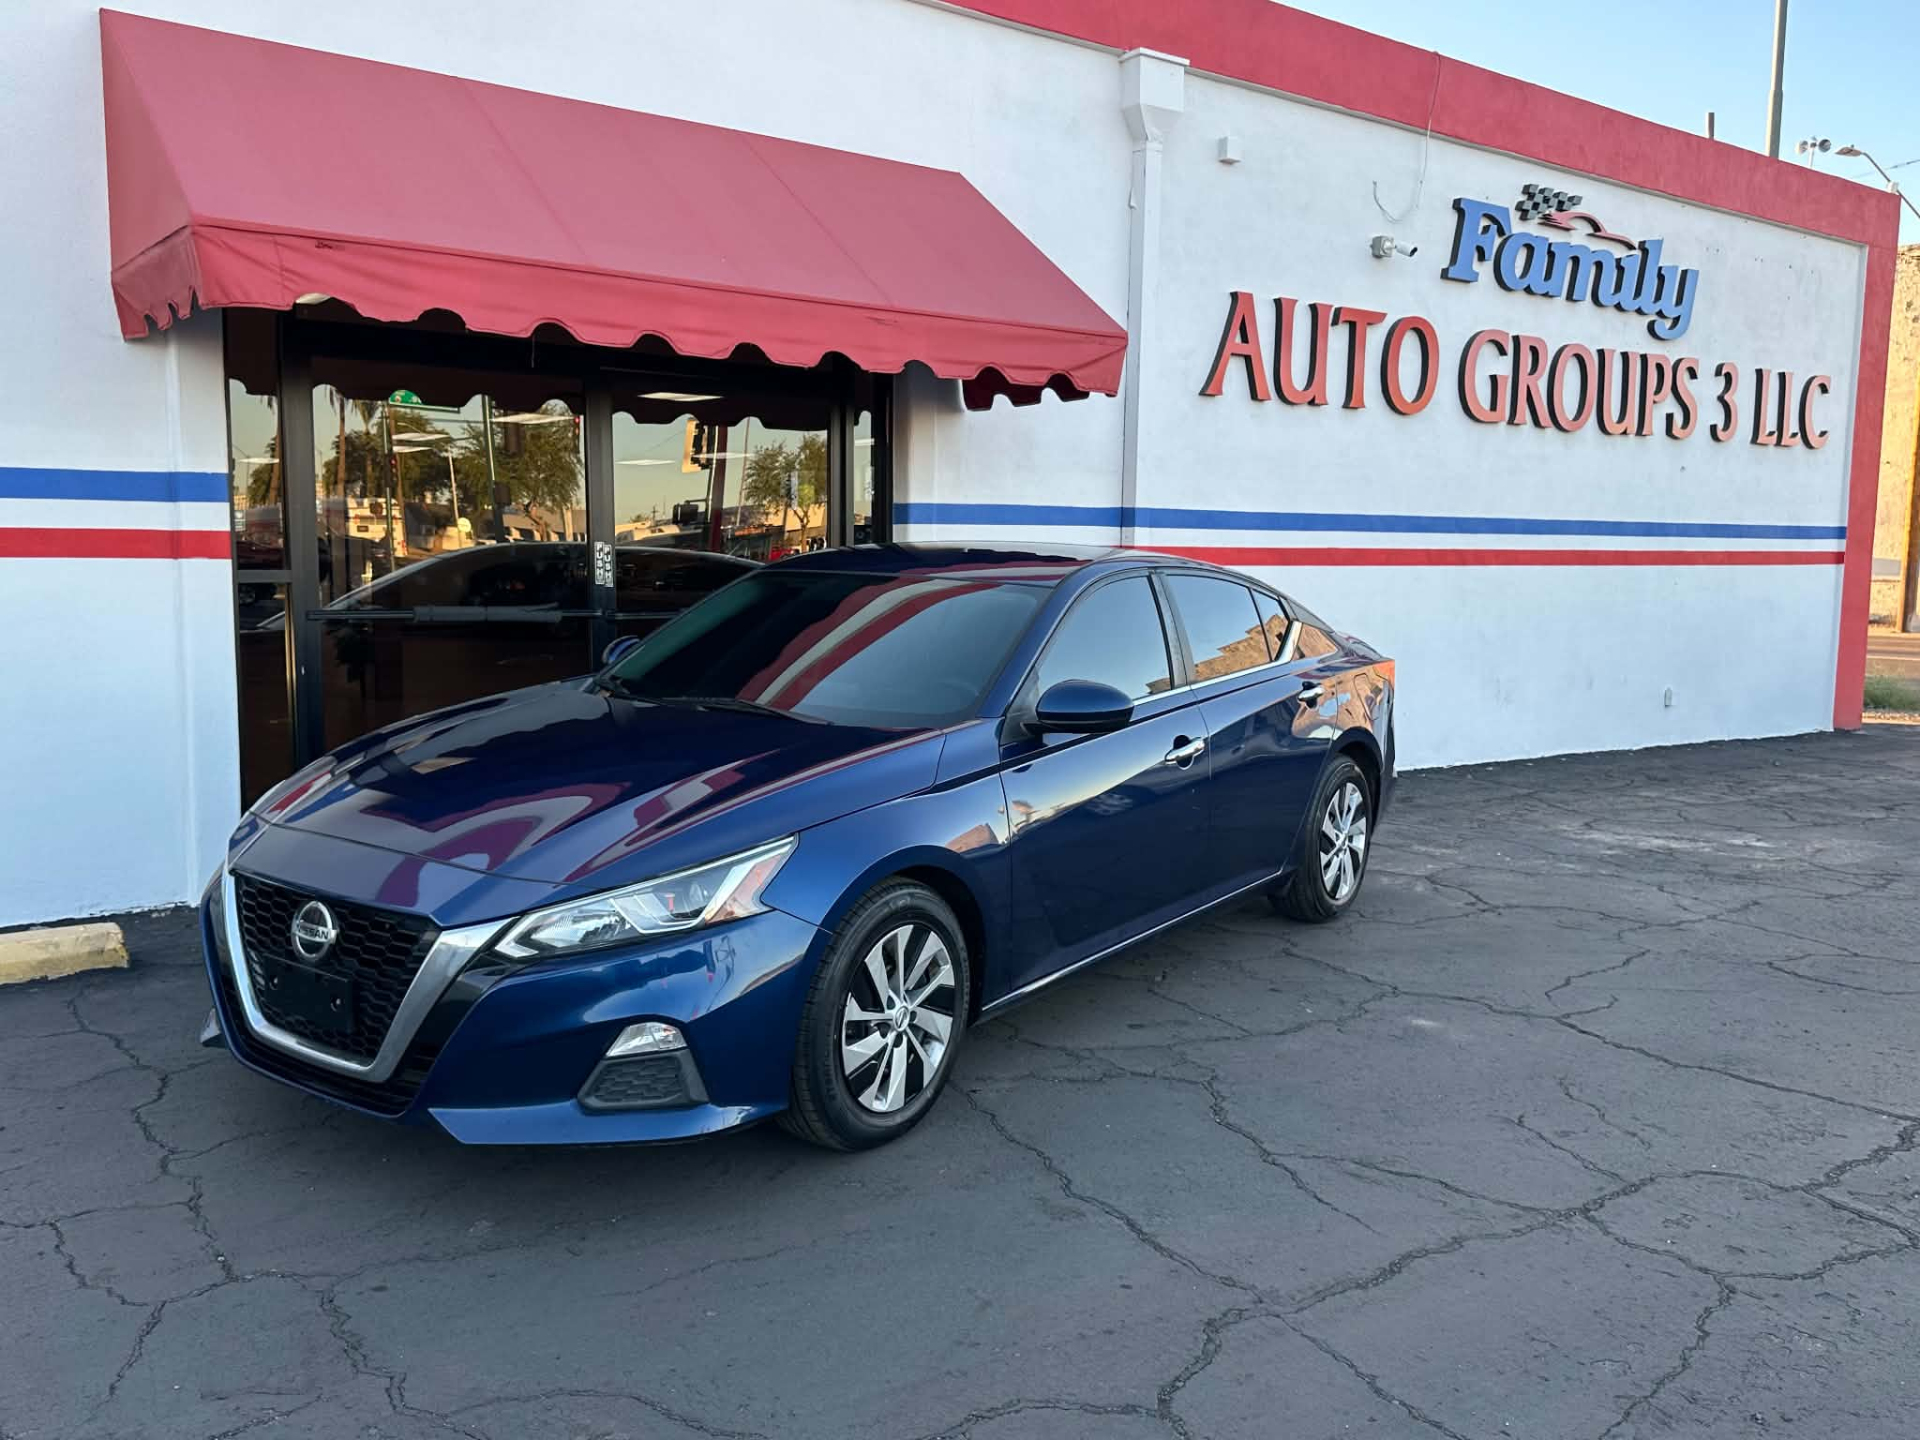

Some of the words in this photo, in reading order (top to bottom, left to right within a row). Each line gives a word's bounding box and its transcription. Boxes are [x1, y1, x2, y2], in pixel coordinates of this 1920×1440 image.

[1440, 197, 1698, 341] Family
[1200, 291, 1440, 415] AUTO
[1458, 329, 1699, 440] GROUPS
[1709, 361, 1739, 443] 3
[1751, 367, 1832, 450] LLC
[297, 924, 329, 940] SSAN
